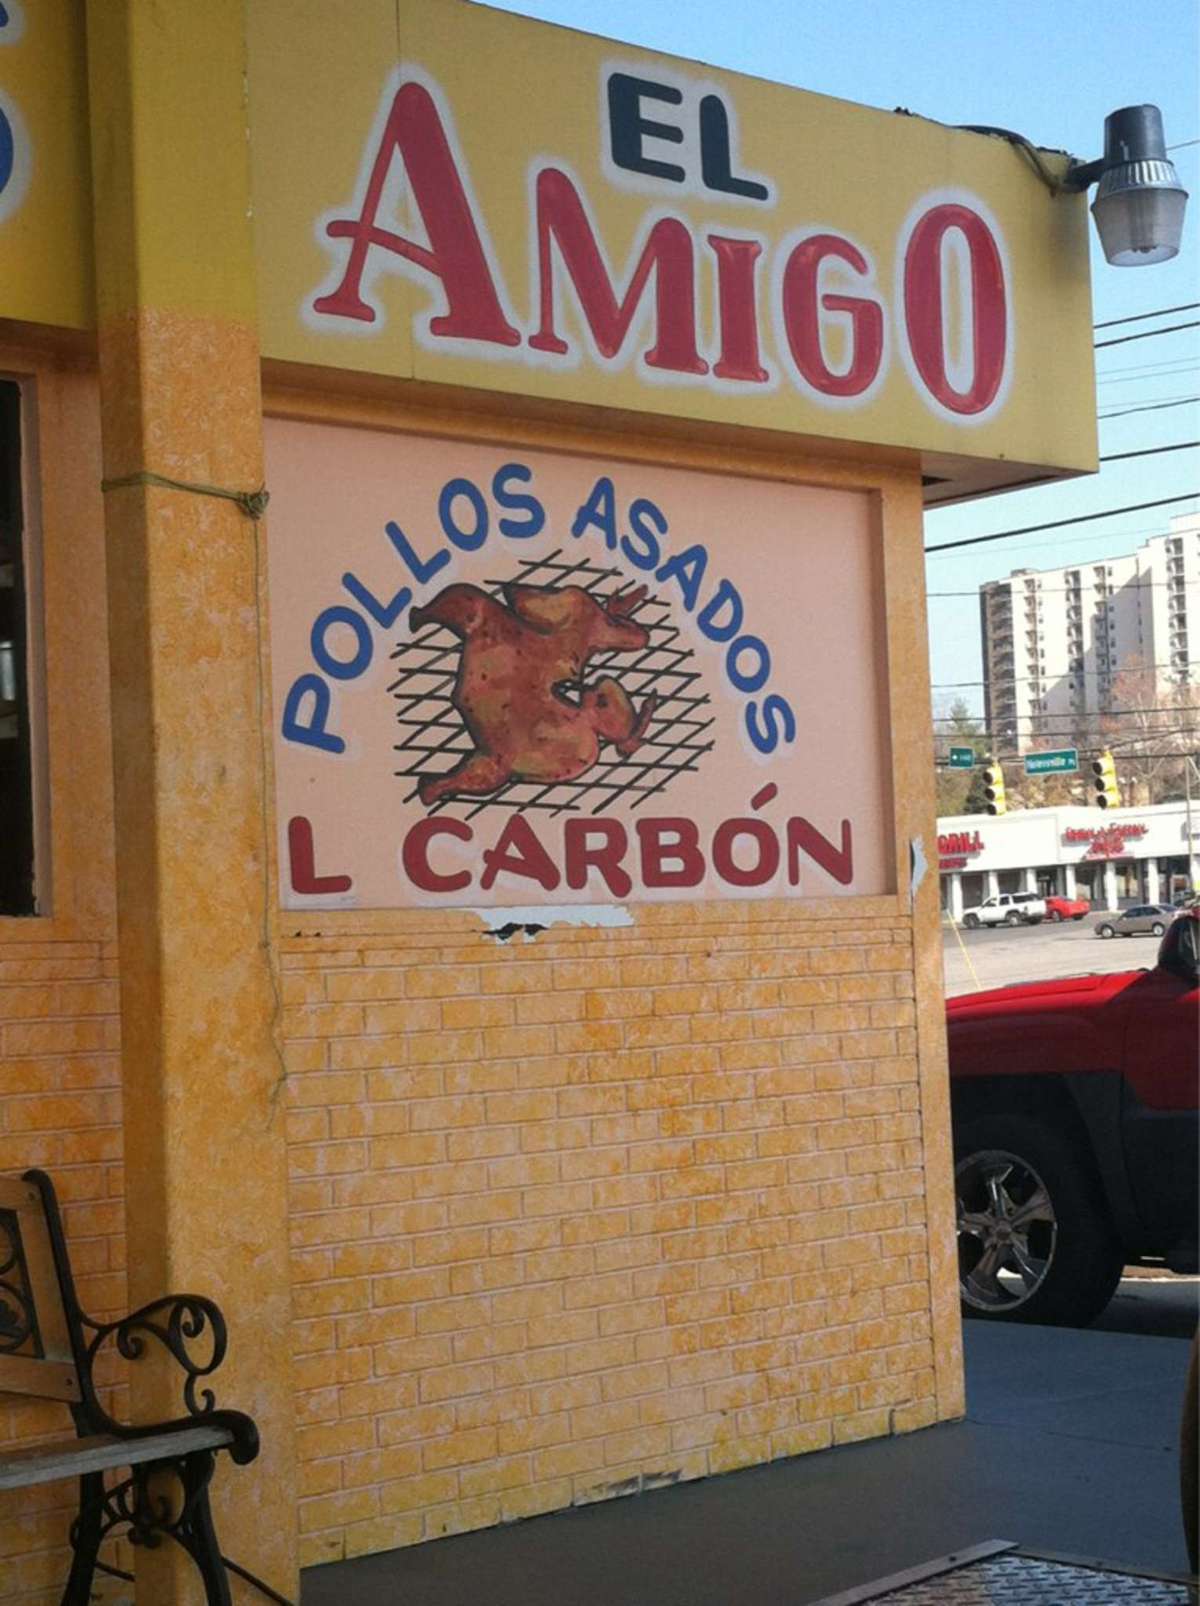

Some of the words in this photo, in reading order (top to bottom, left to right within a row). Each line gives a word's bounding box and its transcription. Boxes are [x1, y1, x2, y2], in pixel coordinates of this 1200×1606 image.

[607, 72, 769, 201] EL
[313, 82, 1007, 415] AMIGO
[282, 464, 545, 754] POLLOS
[572, 477, 796, 754] ASADOS
[289, 816, 352, 894] L
[403, 783, 853, 897] CARBÓN
